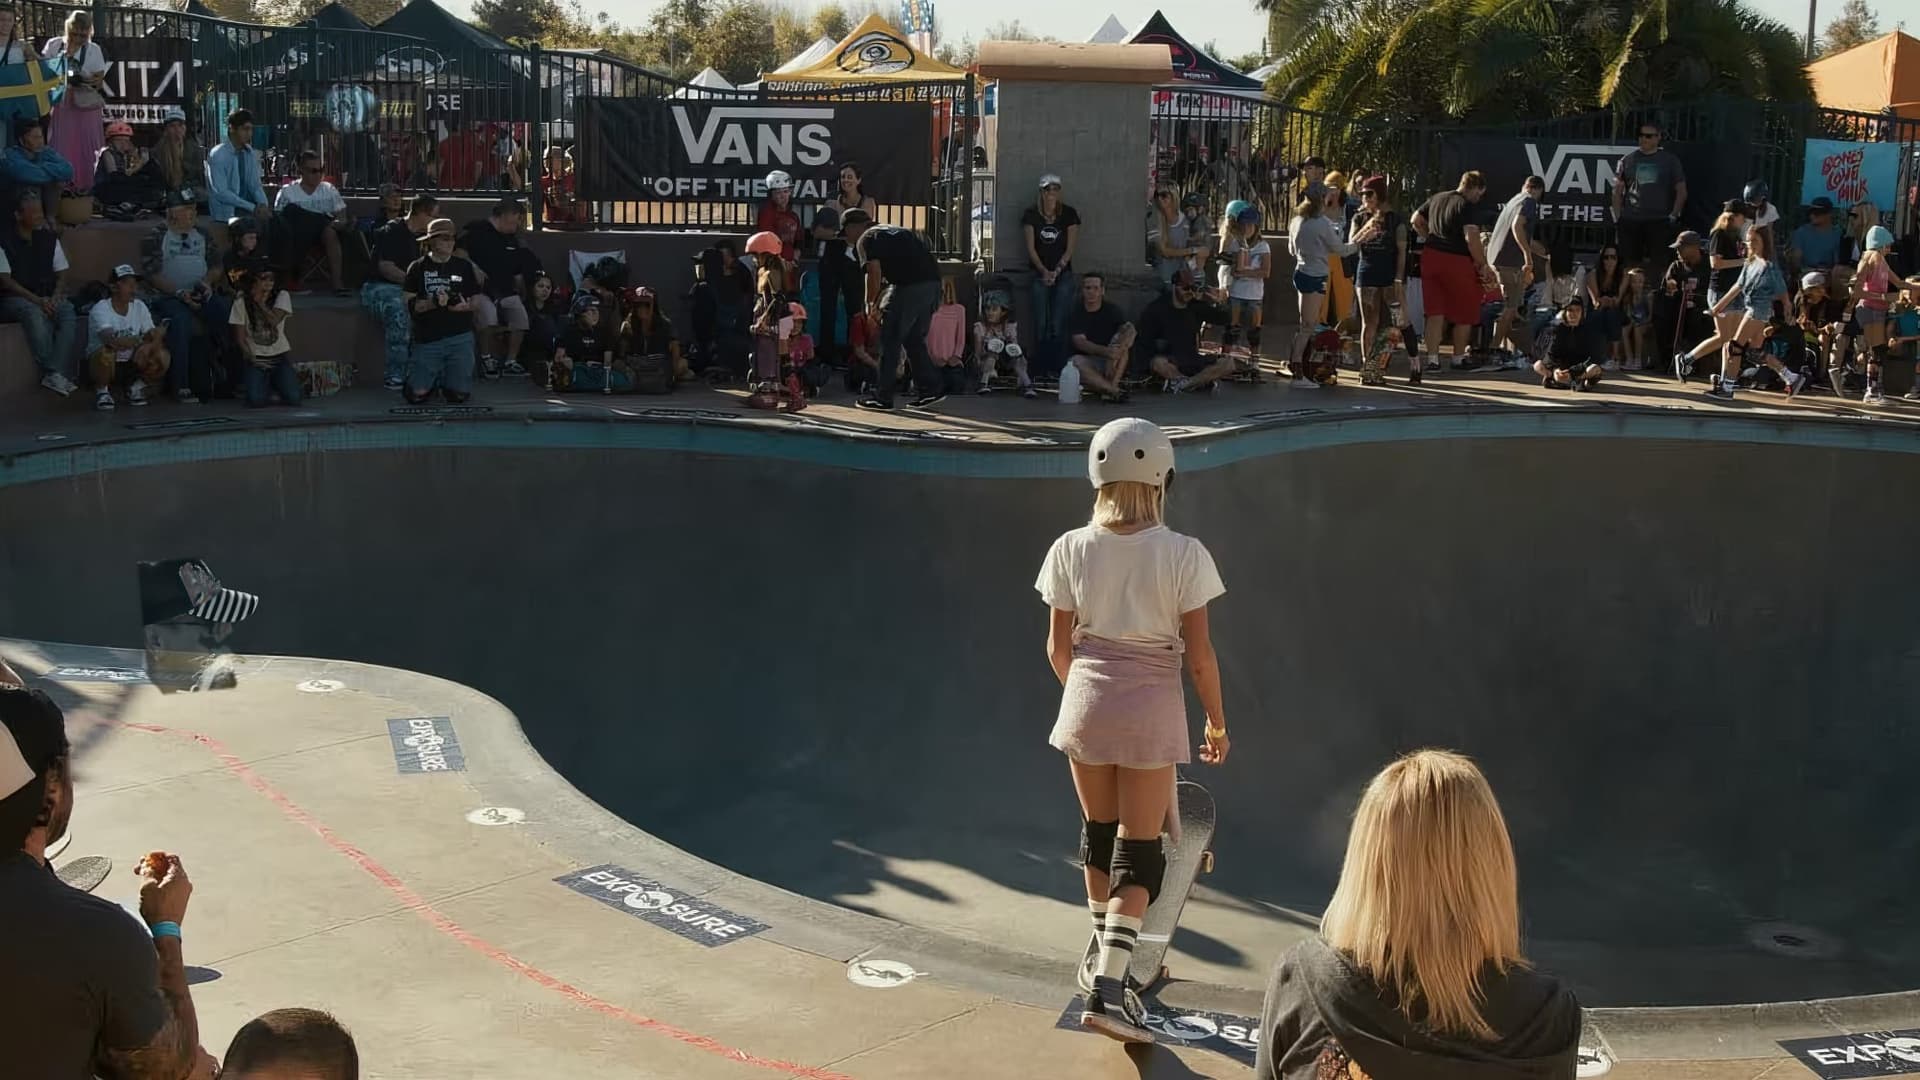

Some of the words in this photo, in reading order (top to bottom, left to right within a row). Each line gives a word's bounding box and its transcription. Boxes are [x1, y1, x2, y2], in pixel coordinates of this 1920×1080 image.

[671, 106, 835, 166] VANS
[643, 176, 707, 197] "OFF
[714, 178, 769, 198] THE
[1558, 205, 1604, 222] THE
[581, 870, 746, 938] EXPOSURE
